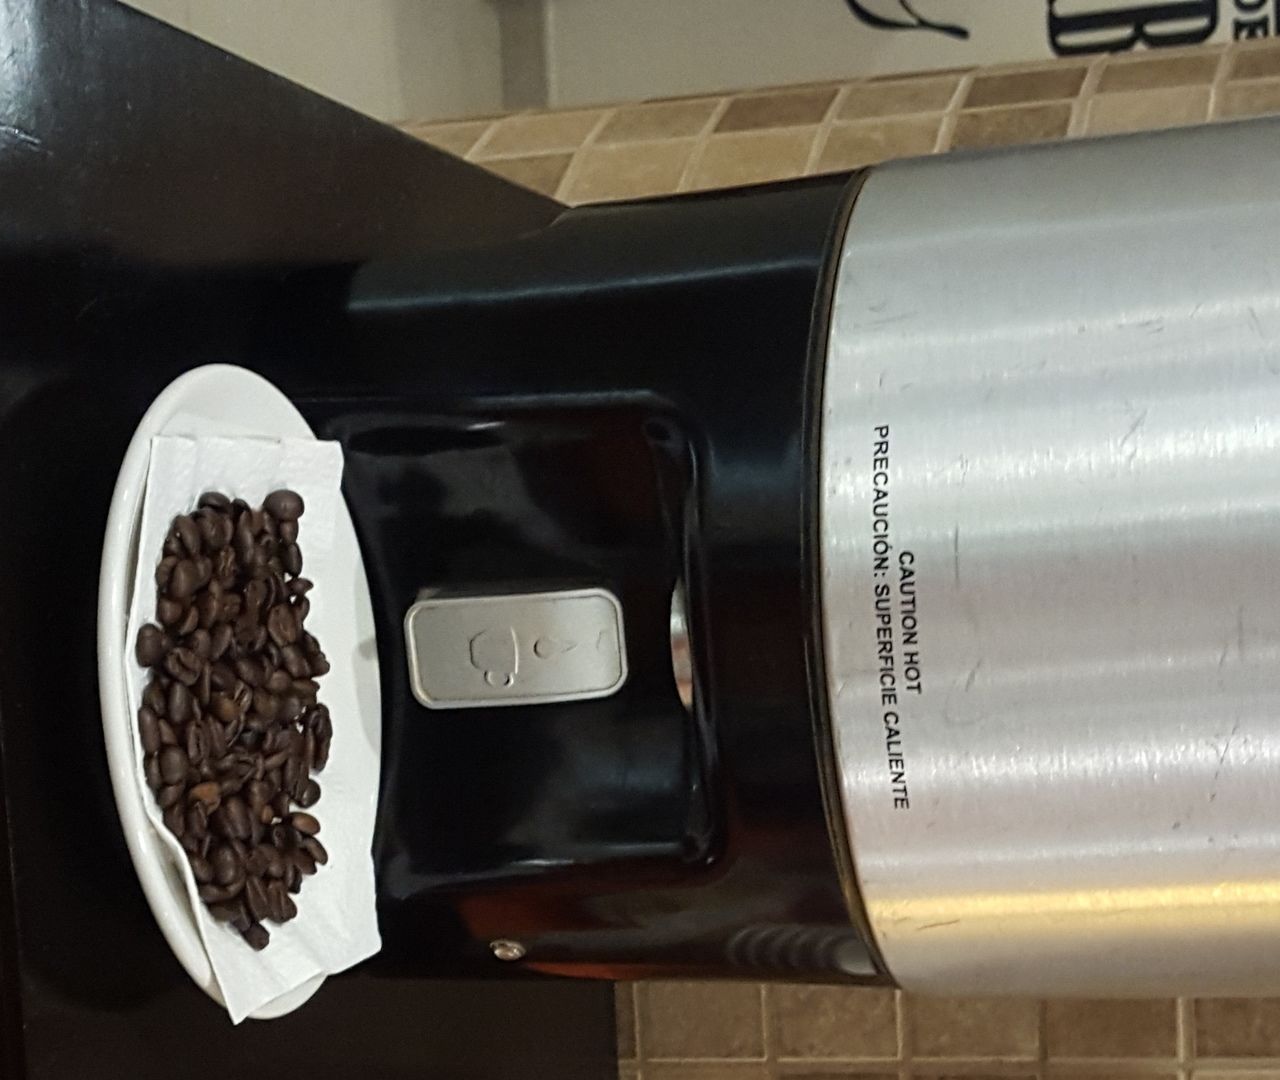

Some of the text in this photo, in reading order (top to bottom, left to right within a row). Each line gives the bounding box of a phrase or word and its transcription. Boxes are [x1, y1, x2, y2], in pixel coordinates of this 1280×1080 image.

[872, 426, 910, 810] PRECAUCIÓN: SUPERFICIE CALIENTE
[898, 551, 922, 695] CAUTION HOT
